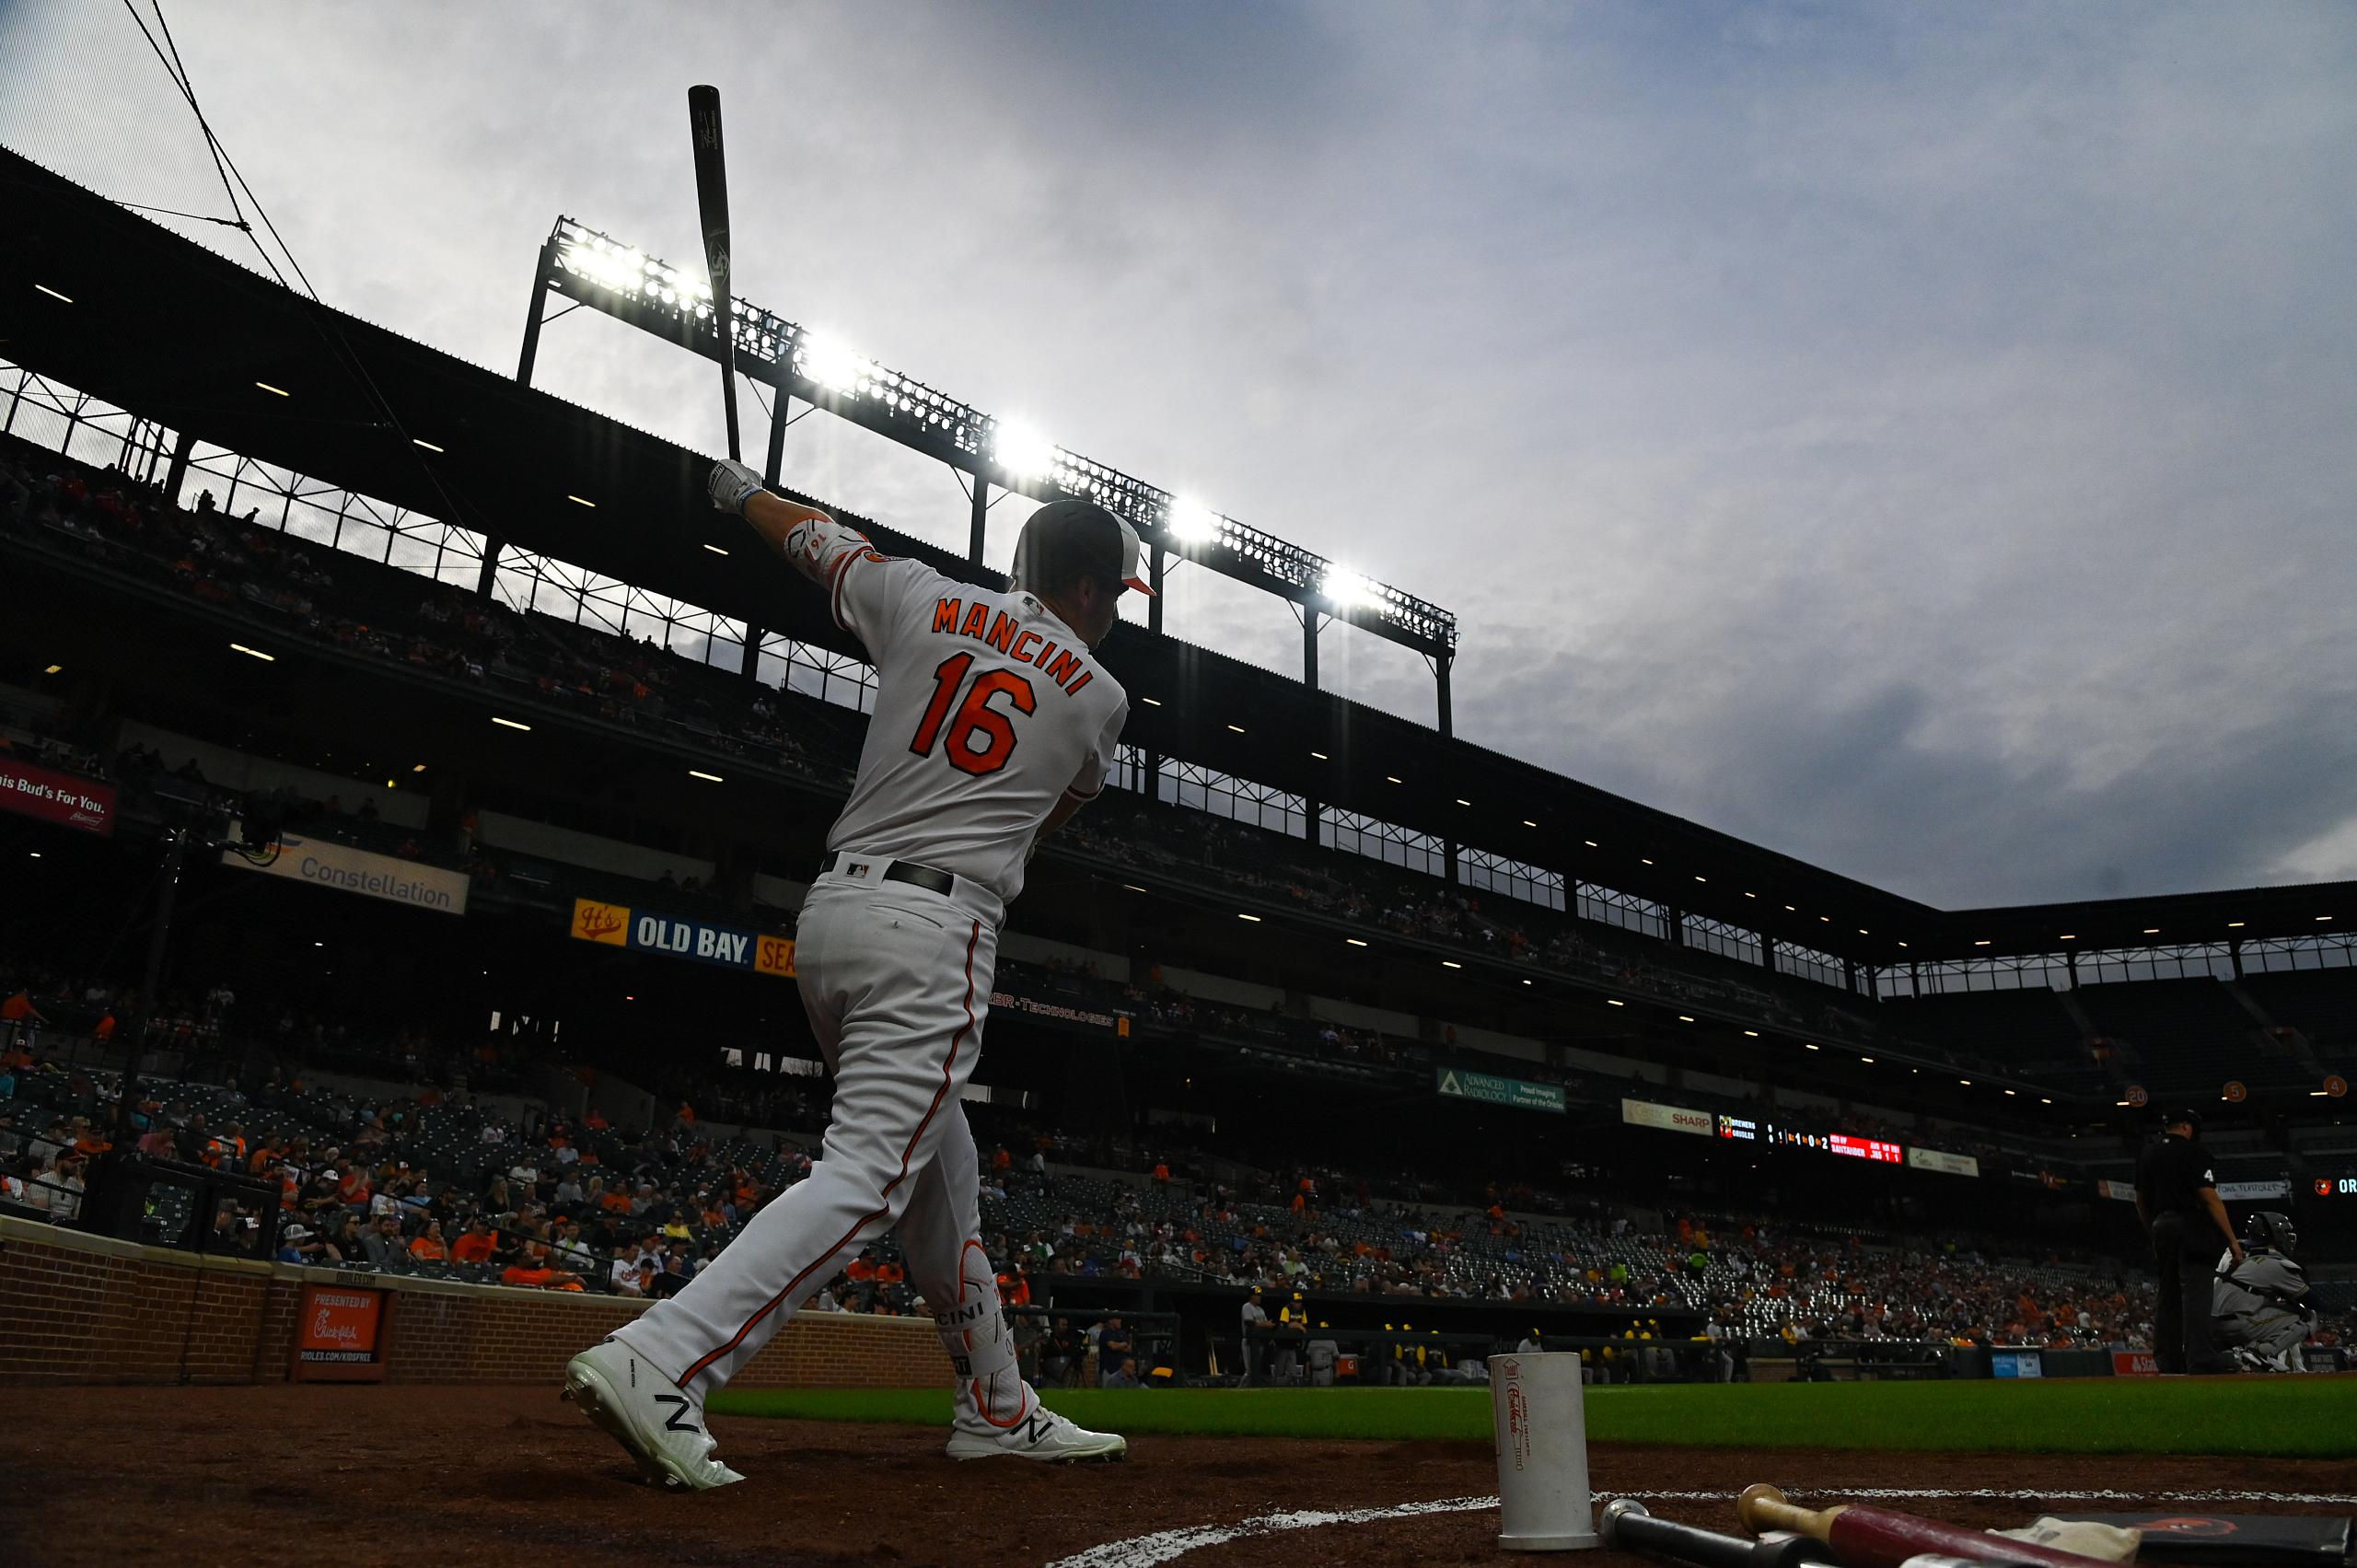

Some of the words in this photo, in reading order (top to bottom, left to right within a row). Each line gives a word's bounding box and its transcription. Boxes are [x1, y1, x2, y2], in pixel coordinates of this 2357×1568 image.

[932, 598, 1094, 697] MANCINI
[909, 651, 1038, 777] 16
[17, 778, 54, 799] Bud's
[56, 789, 77, 806] For
[79, 796, 105, 814] You.
[301, 857, 450, 907] Constellation
[581, 906, 621, 937] It's
[637, 916, 691, 953] OLD
[1464, 1073, 1504, 1090] ADVANCED
[2330, 1080, 2340, 1092] 4
[1464, 1085, 1508, 1102] RADIOLOGY
[2129, 1090, 2145, 1102] 20
[1672, 1113, 1710, 1128] SHARP
[1808, 1134, 1815, 1148] 0
[1821, 1136, 1829, 1150] 2
[2203, 1168, 2214, 1182] 4
[2339, 1179, 2357, 1194] OR
[314, 1294, 360, 1307] PRESENTED
[360, 1297, 371, 1308] BY
